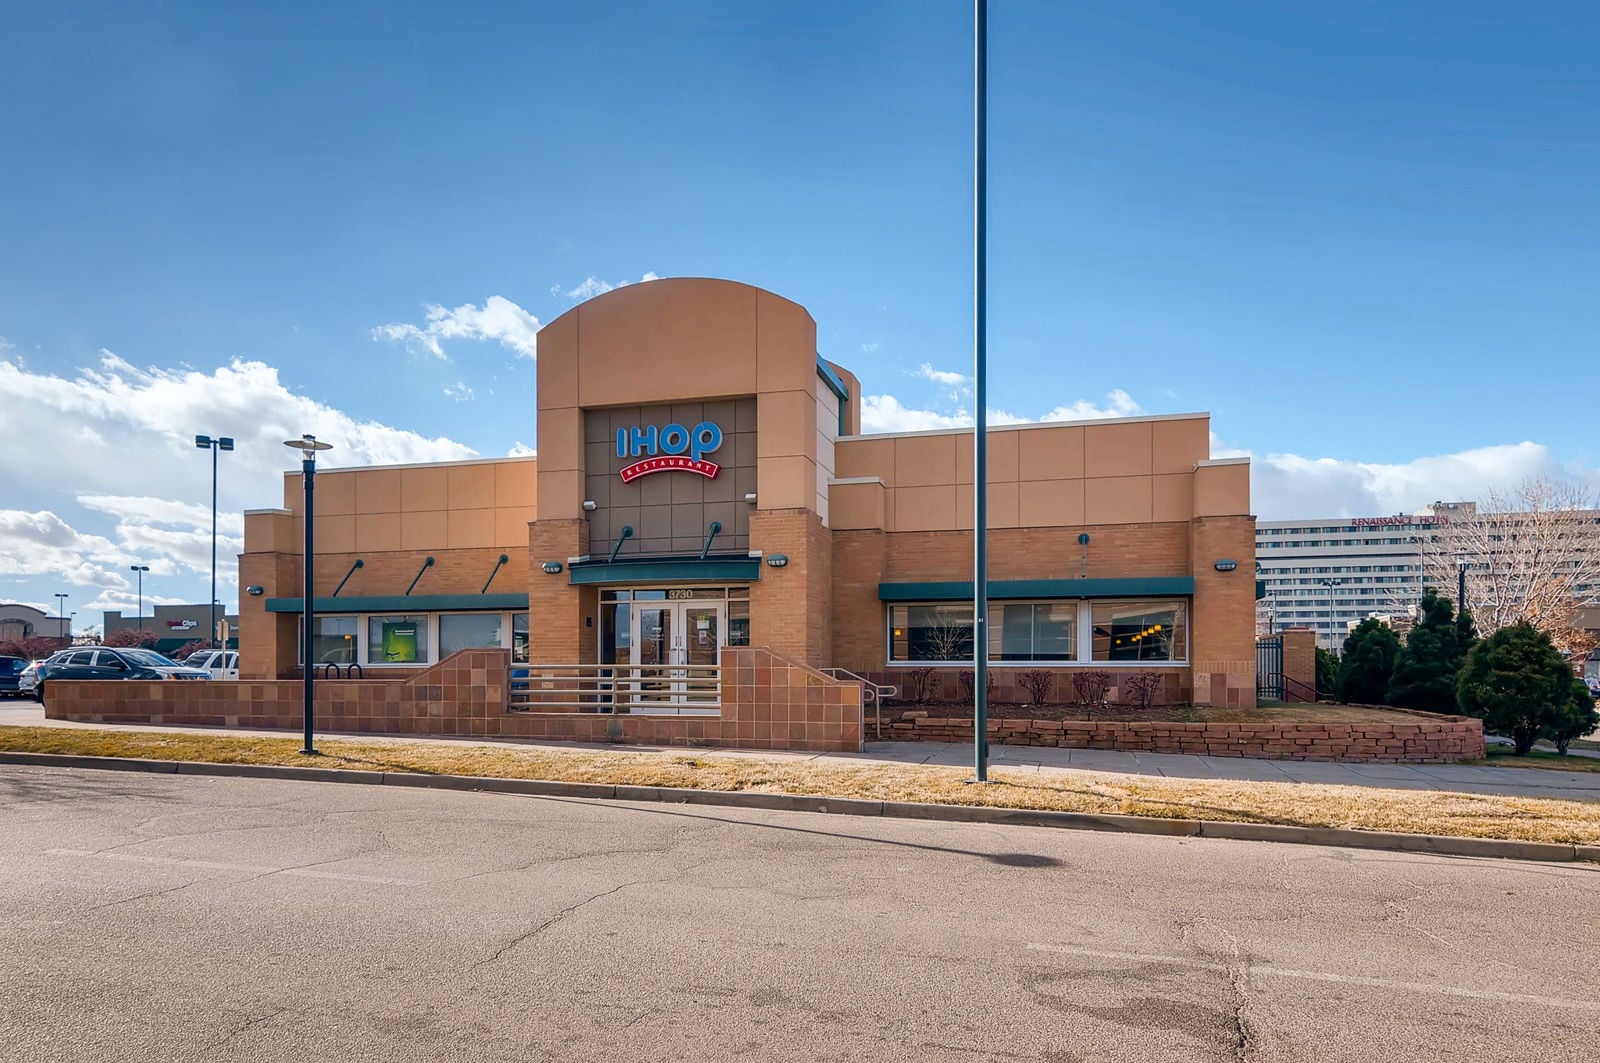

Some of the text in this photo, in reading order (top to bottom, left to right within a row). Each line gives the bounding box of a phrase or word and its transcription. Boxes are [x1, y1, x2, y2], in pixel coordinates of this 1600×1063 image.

[616, 421, 723, 463] IHOP
[627, 459, 711, 475] RESTAURANT
[1351, 516, 1412, 526] RENAISSANCE
[669, 590, 693, 599] 3730
